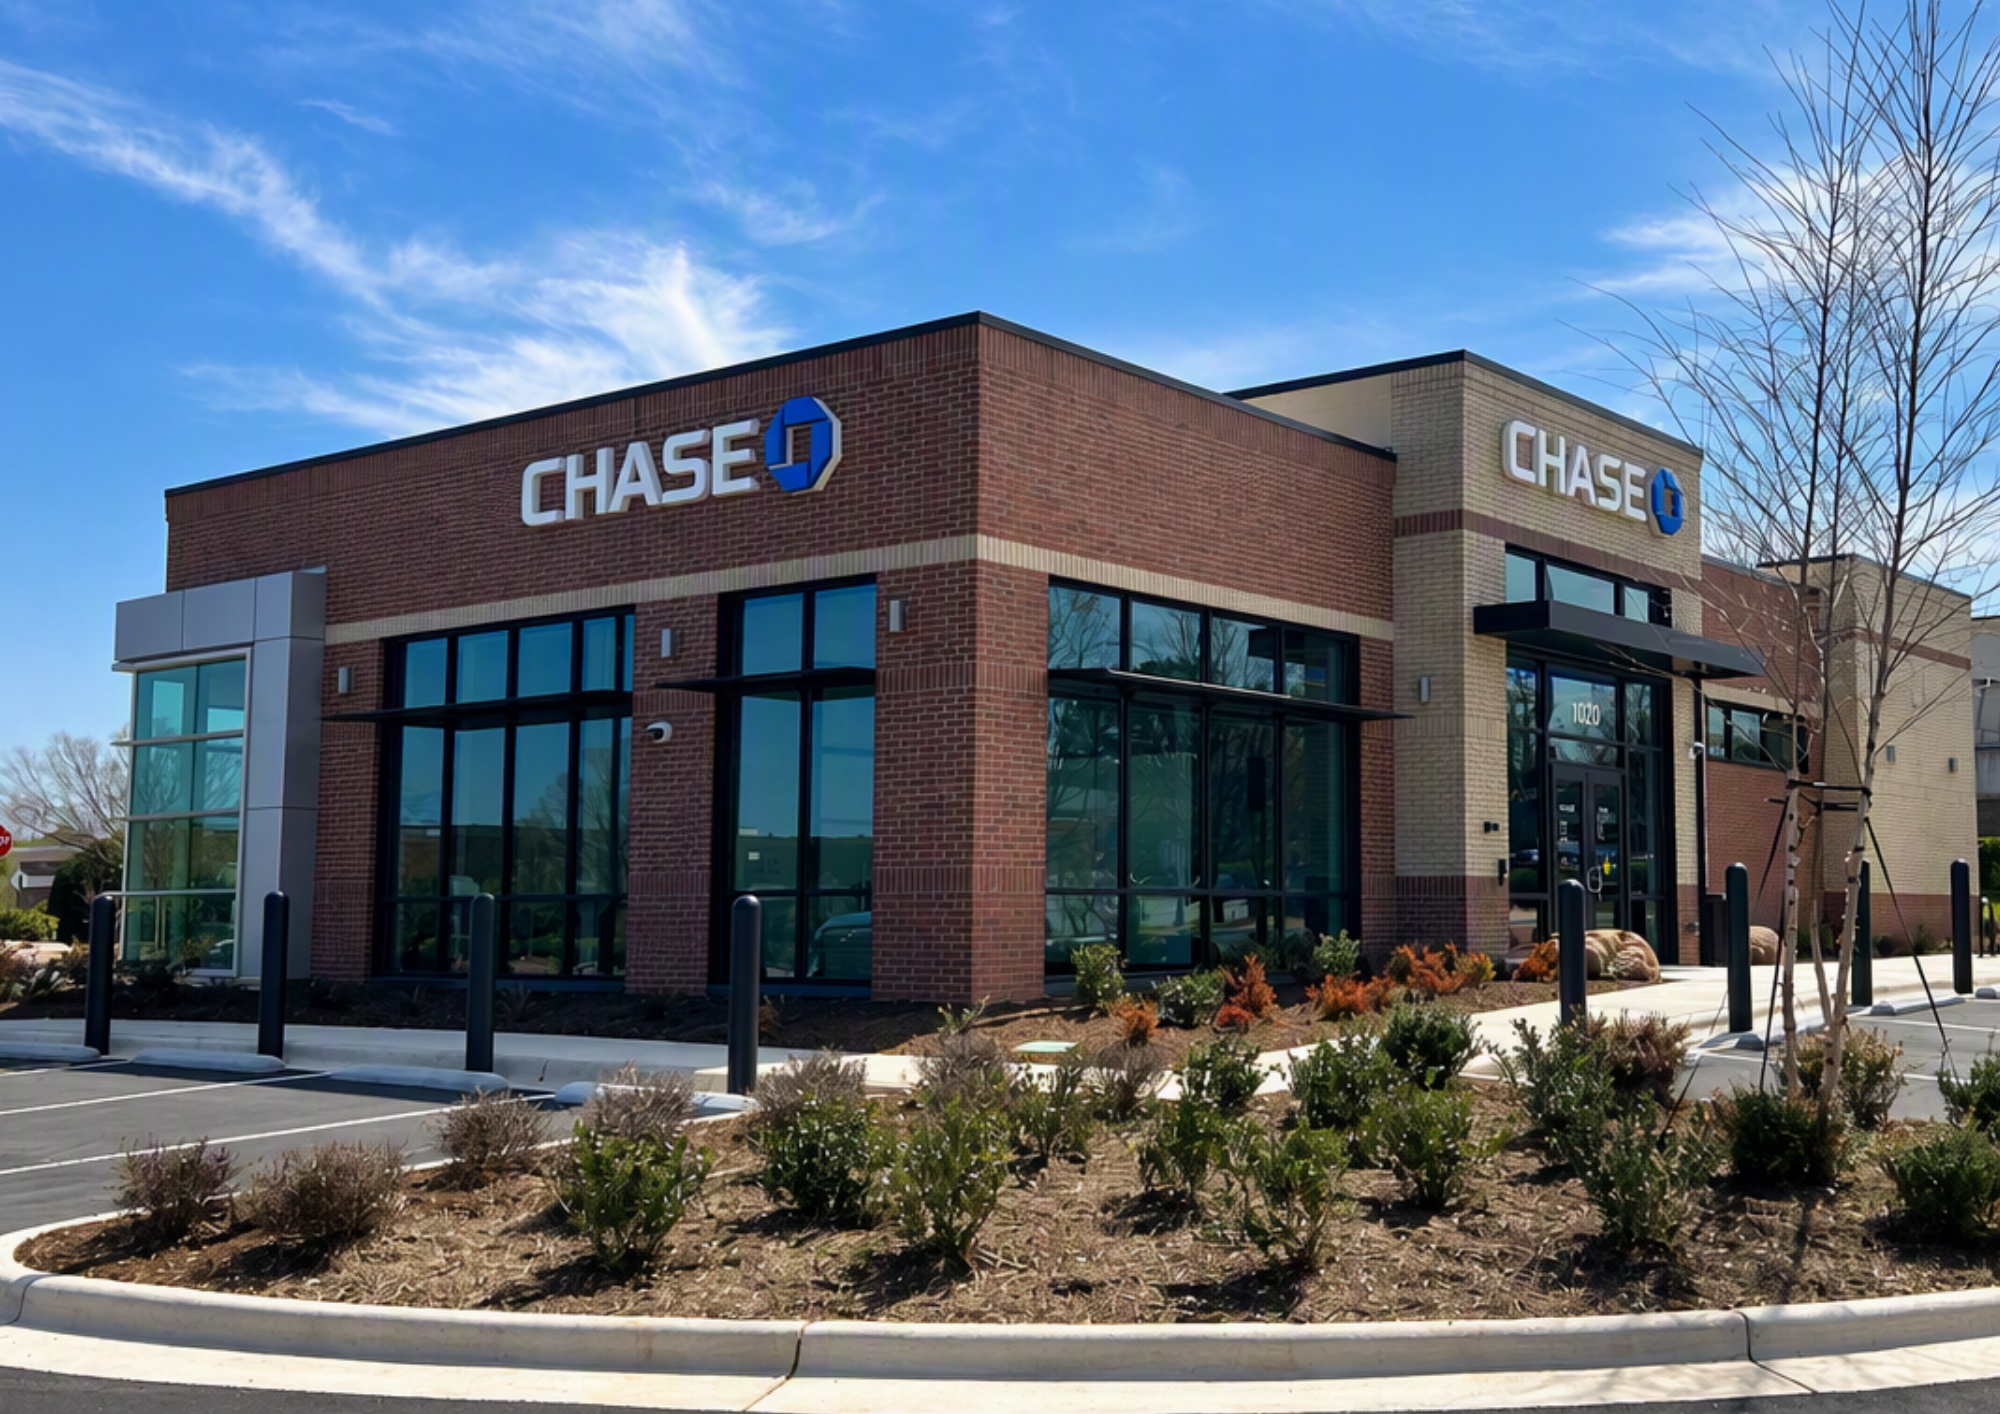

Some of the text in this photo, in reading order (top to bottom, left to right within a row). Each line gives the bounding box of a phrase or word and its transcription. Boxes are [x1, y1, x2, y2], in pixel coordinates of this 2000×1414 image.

[521, 418, 760, 526] CHASE
[1503, 420, 1647, 522] CHASE
[1572, 702, 1601, 726] 1020
